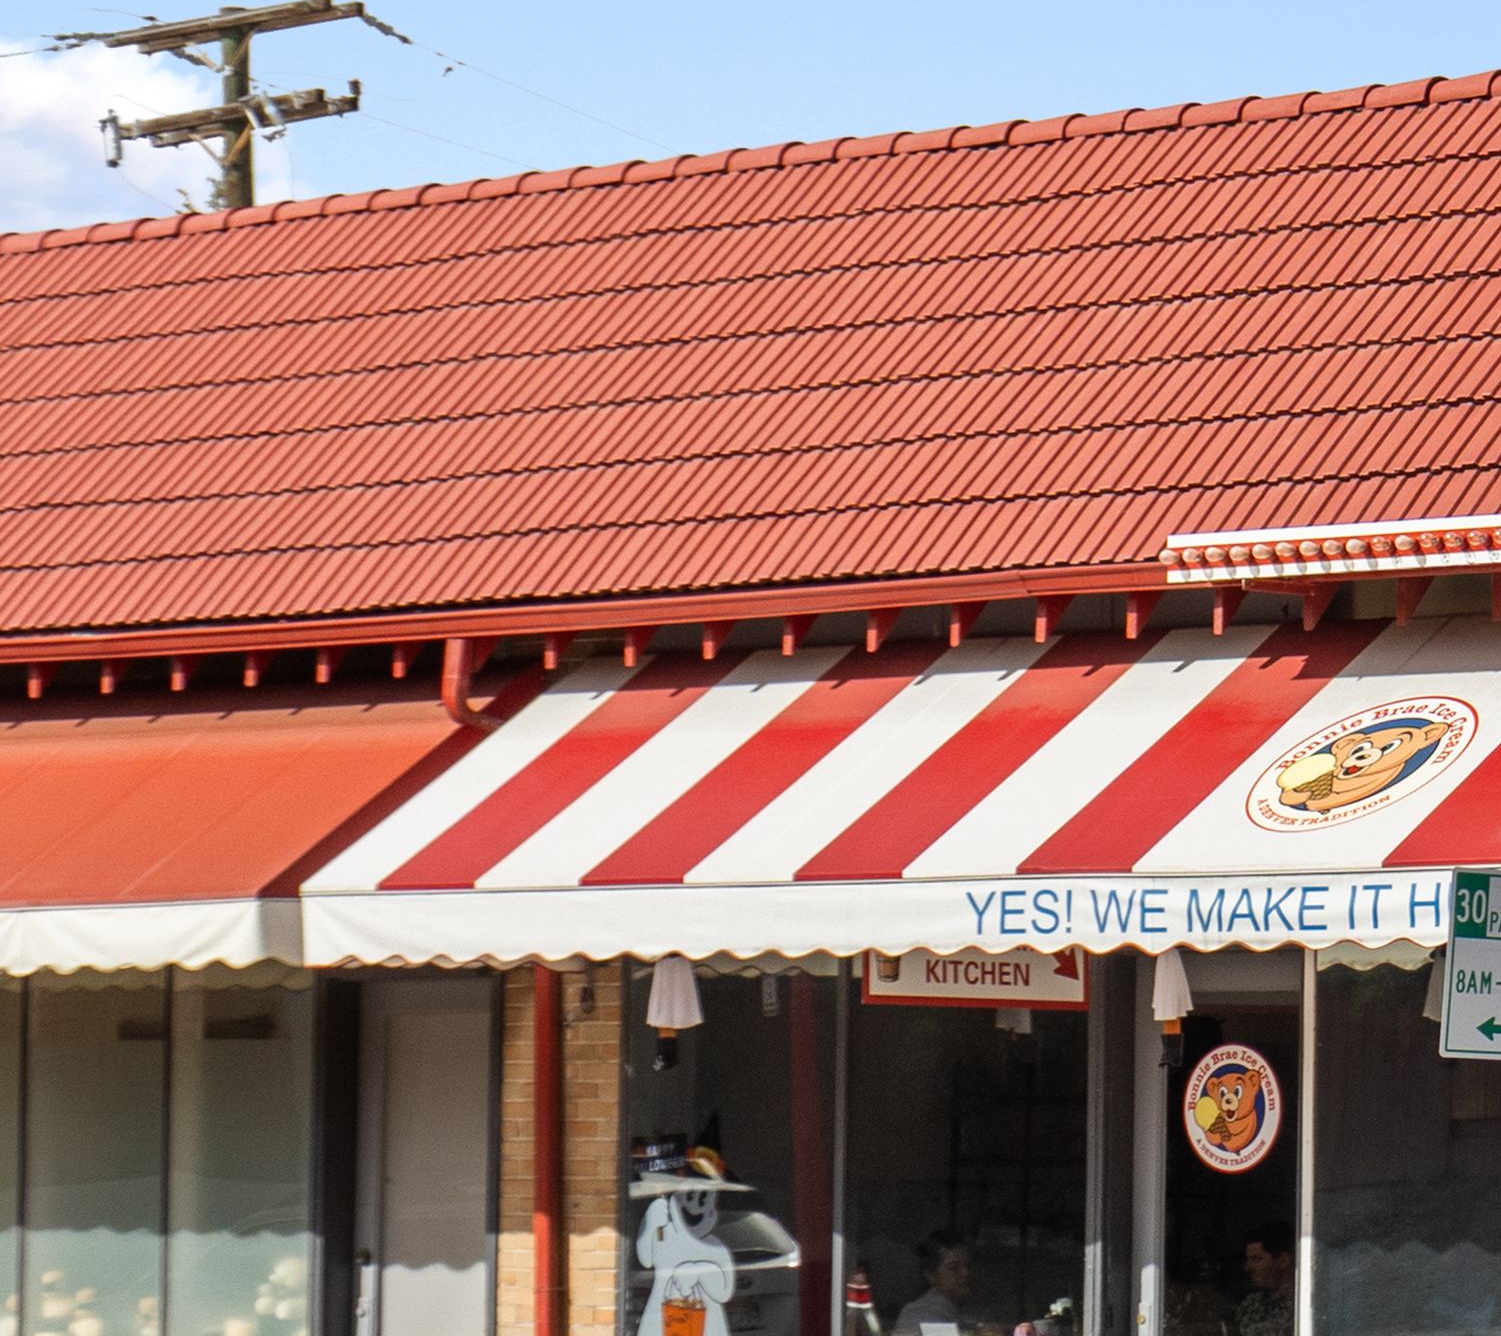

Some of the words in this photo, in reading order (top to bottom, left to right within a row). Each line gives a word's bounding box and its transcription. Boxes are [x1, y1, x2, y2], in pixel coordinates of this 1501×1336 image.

[1372, 703, 1429, 722] Brae
[1427, 701, 1457, 722] Ice
[1275, 716, 1364, 772] Bonnie
[1431, 716, 1468, 767] Cream
[965, 887, 1074, 938] YES!
[1089, 887, 1169, 935] WE
[1186, 886, 1329, 935] MAKE
[1348, 883, 1393, 930] IT
[1456, 888, 1488, 924] 30
[925, 958, 1031, 987] KITCHEN
